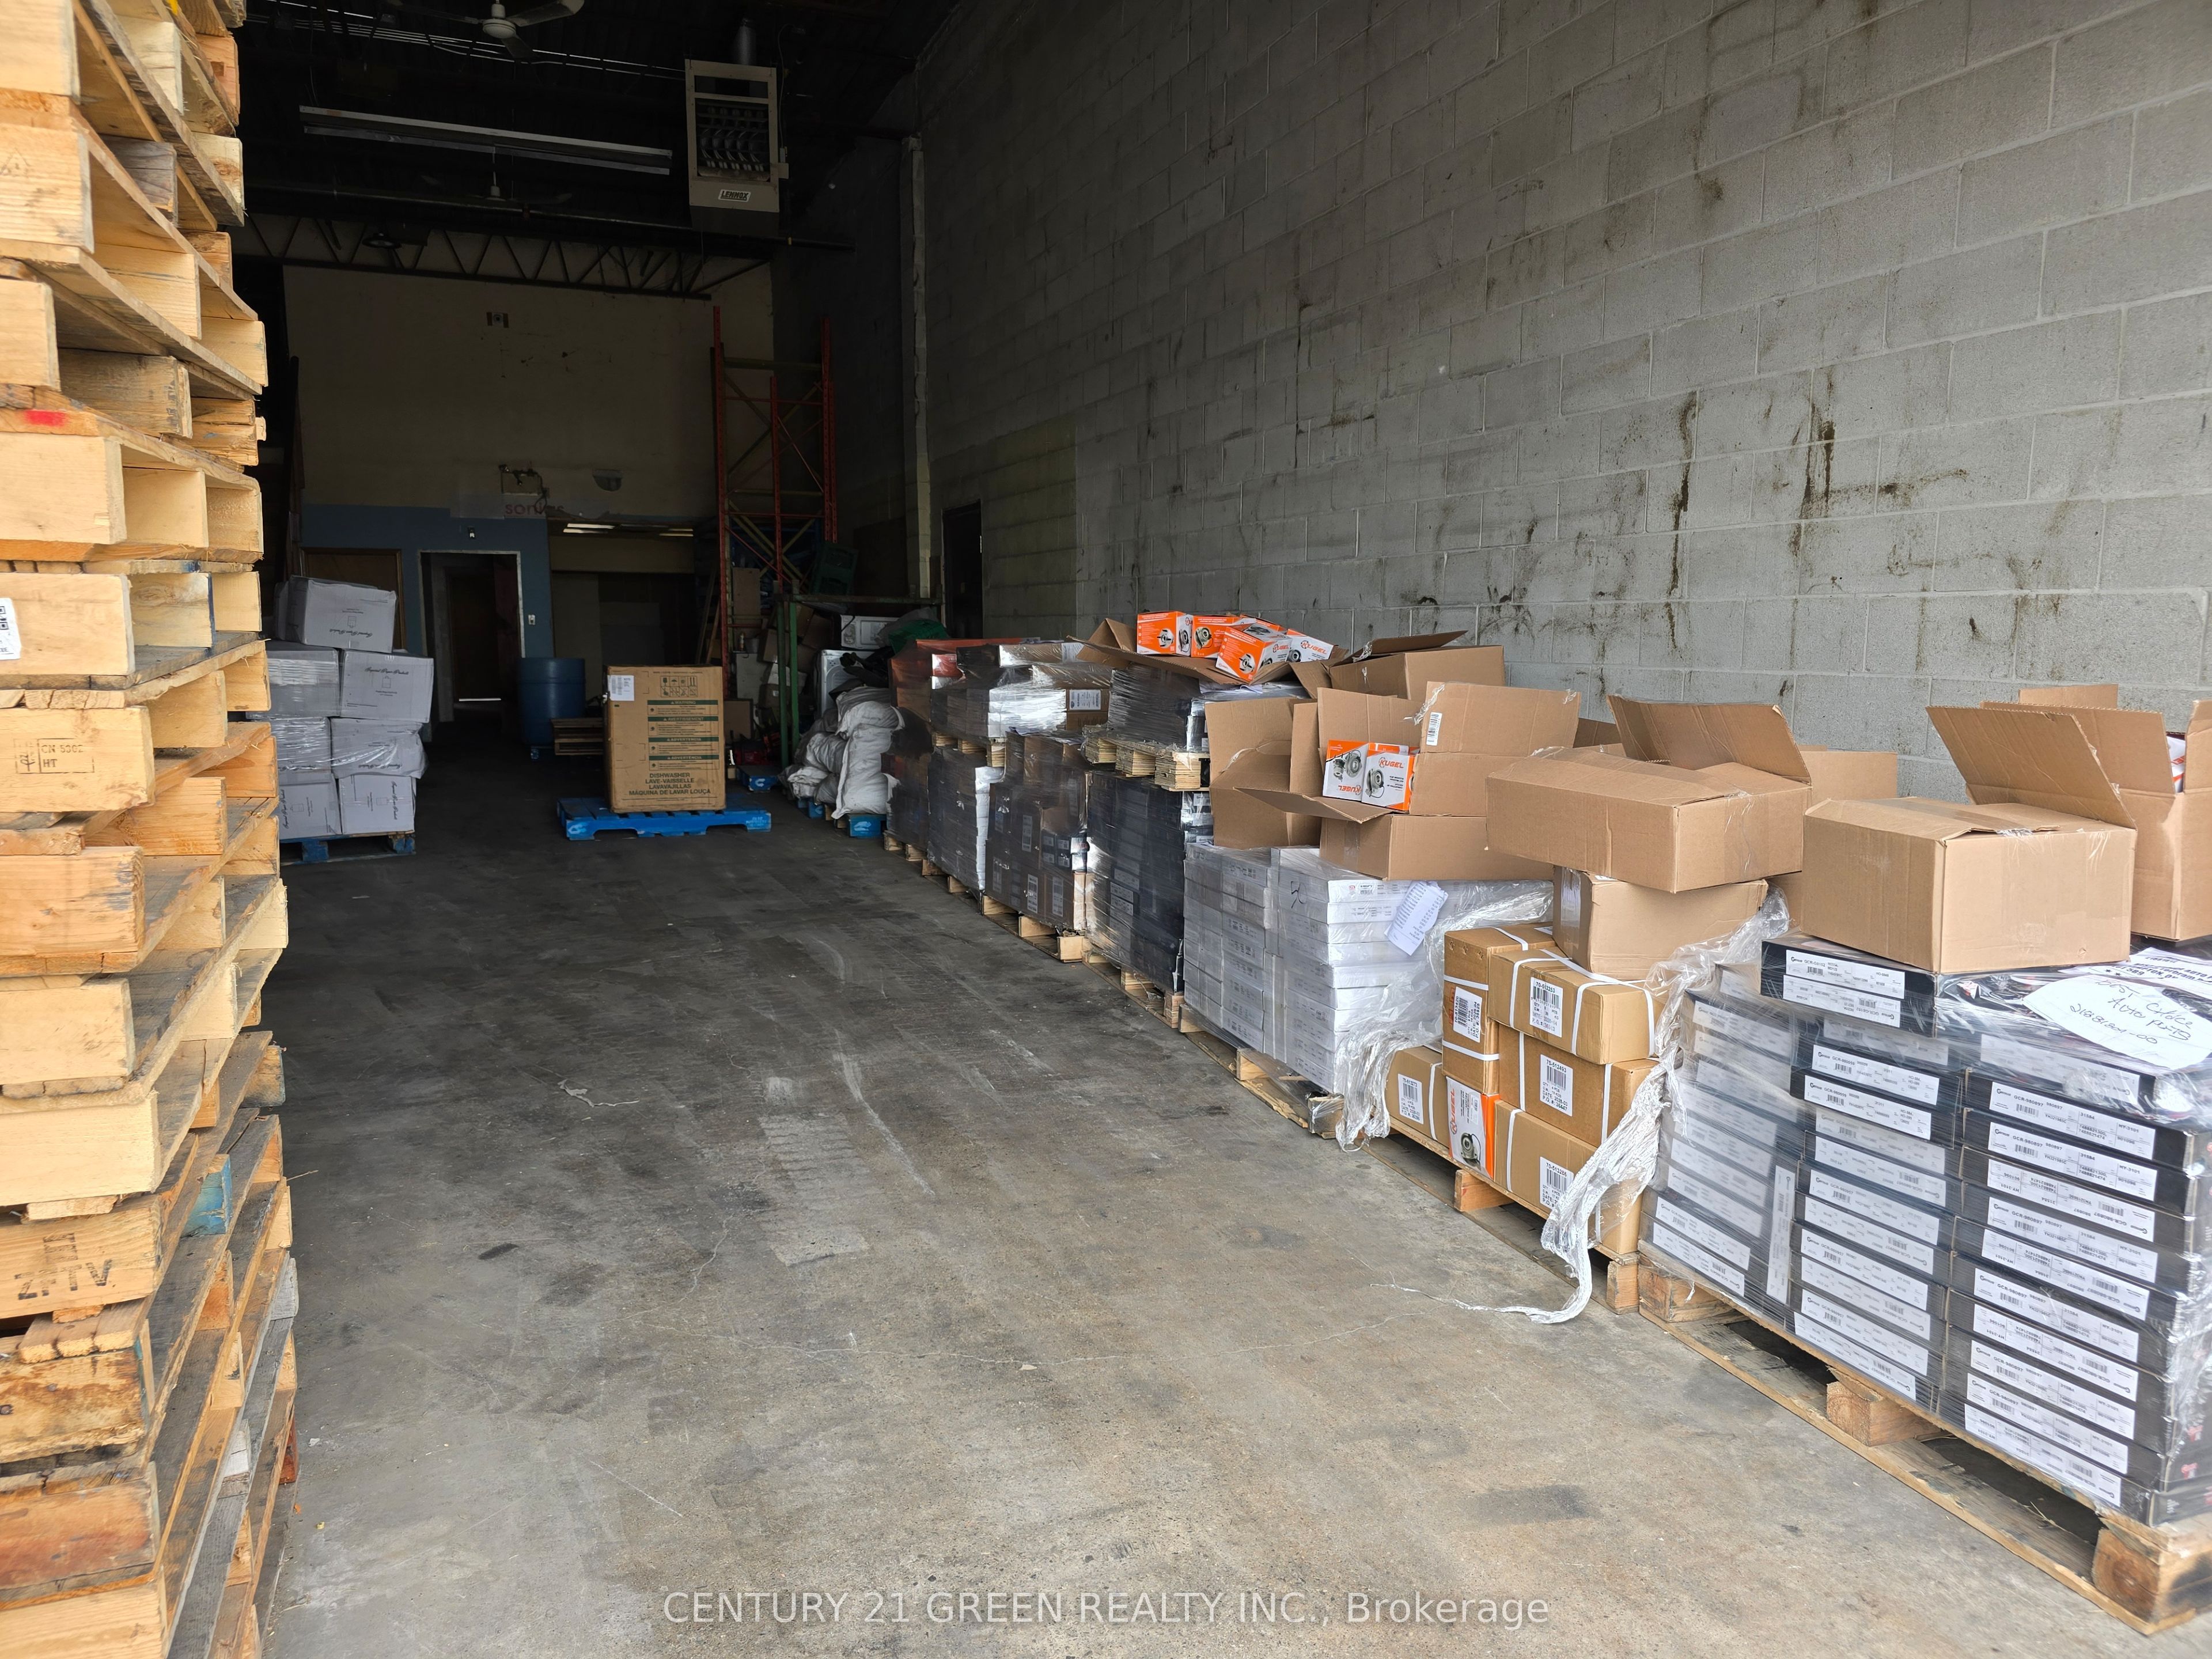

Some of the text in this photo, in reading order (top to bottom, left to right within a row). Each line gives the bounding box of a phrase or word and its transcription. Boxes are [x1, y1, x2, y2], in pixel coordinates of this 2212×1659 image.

[721, 191, 749, 199] LENNOX
[1273, 644, 1290, 653] KUGEL
[1301, 641, 1327, 654] KUGEL
[41, 745, 55, 753] CN
[43, 759, 58, 767] HT
[1379, 757, 1404, 768] KUGEL
[1338, 785, 1361, 796] KUGEL
[1546, 1059, 1566, 1073] 70-512493
[2014, 1095, 2043, 1107] GCR-980897
[2013, 1135, 2043, 1148] GCR-980897
[2080, 1153, 2095, 1161] 31584
[2012, 1211, 2043, 1225] GCR-980897
